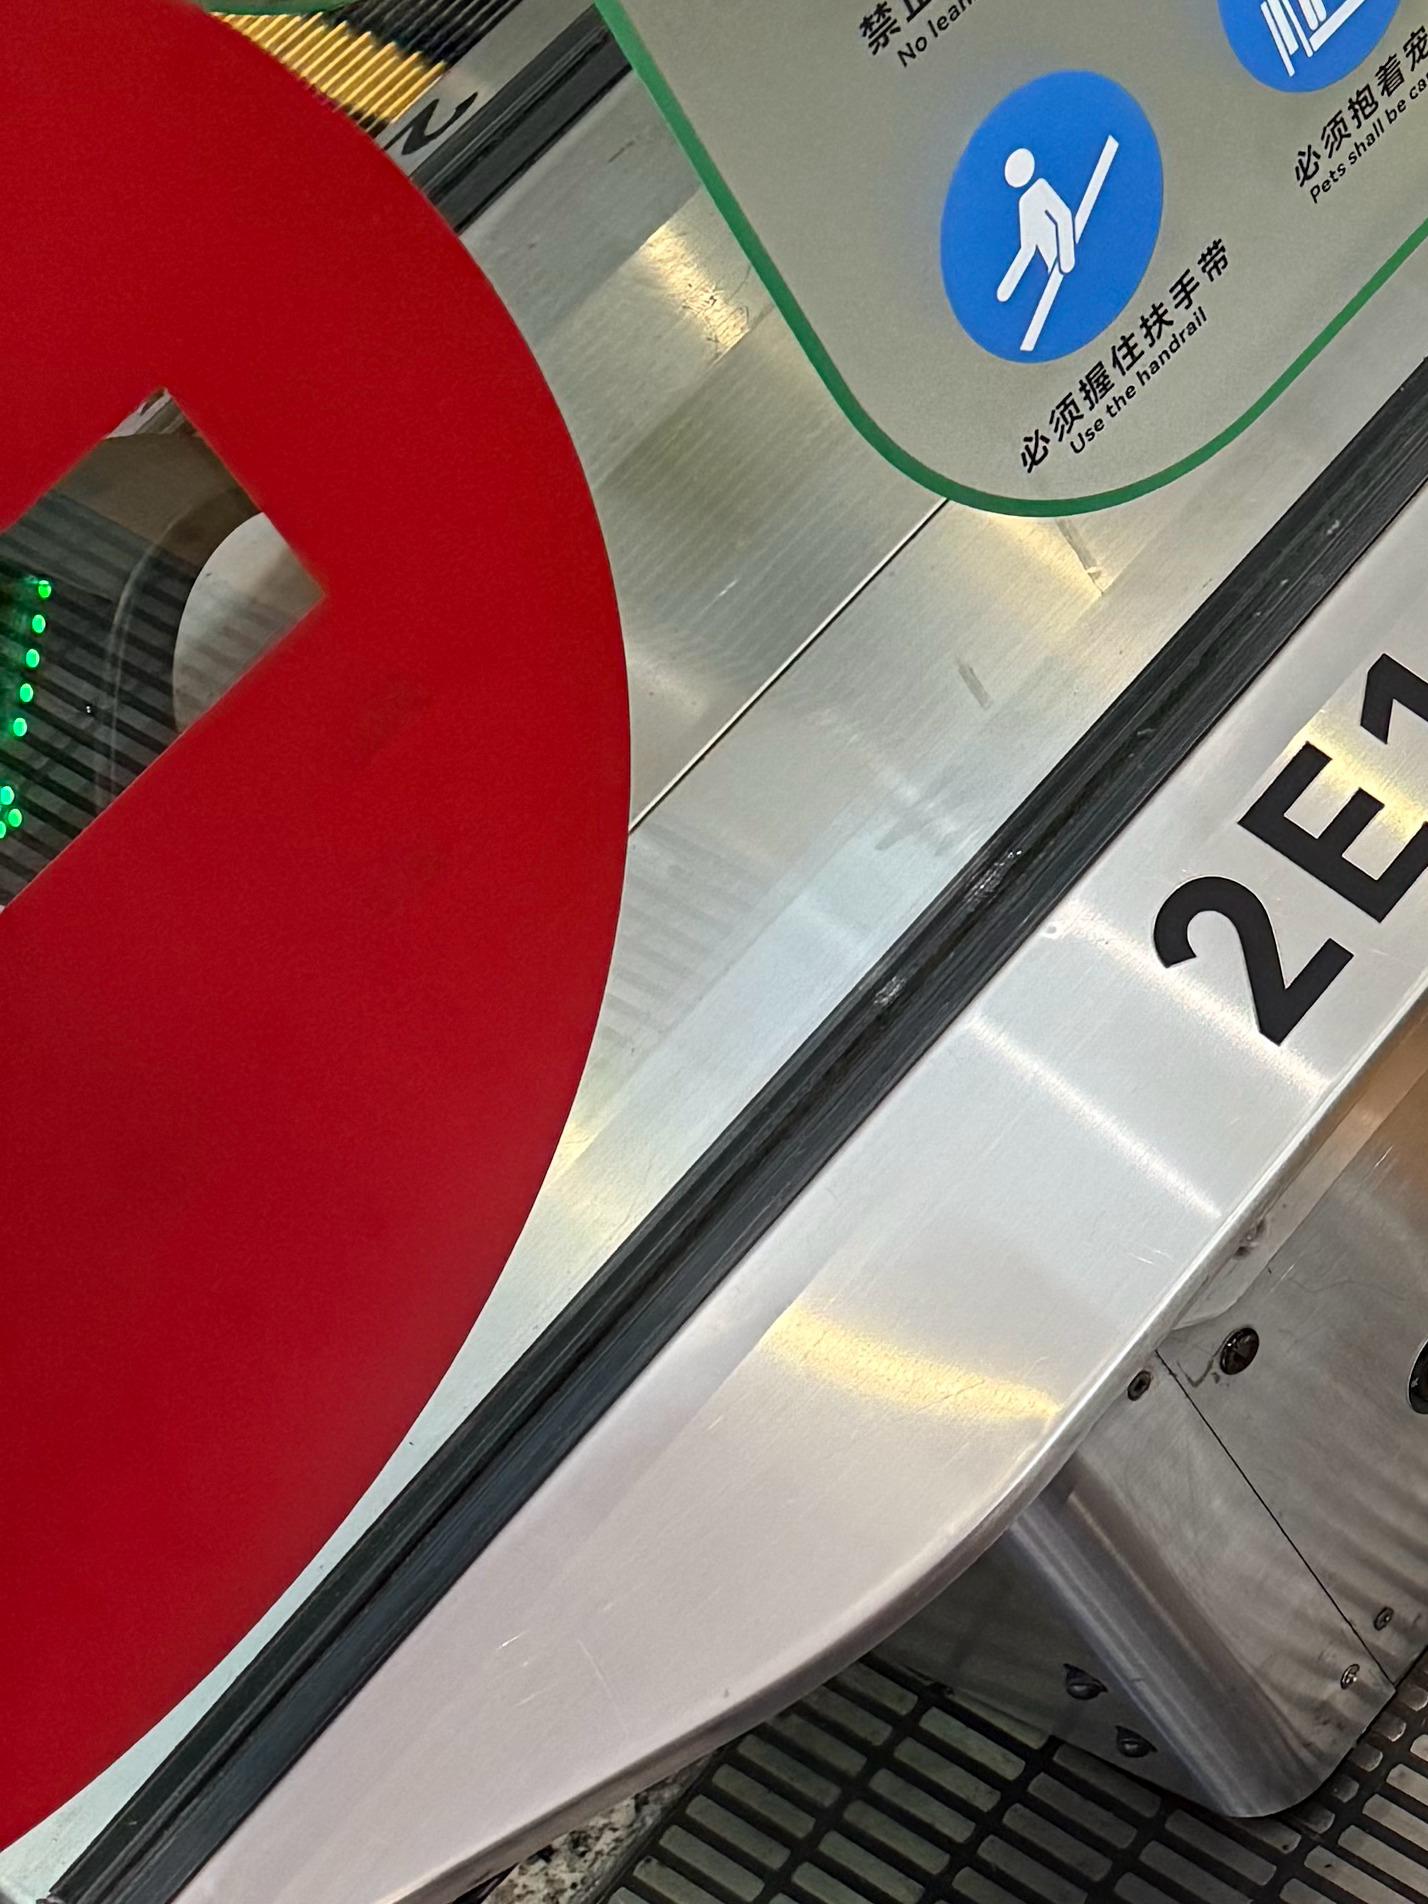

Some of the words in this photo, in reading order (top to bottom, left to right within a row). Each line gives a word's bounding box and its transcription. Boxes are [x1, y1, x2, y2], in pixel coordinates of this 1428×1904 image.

[897, 36, 927, 68] No
[1309, 162, 1347, 204] Pets
[1347, 118, 1385, 165] shall
[1385, 99, 1407, 124] be
[1020, 237, 1229, 474] 必须握住扶手带
[1070, 418, 1105, 454] Use
[1106, 383, 1137, 418] the
[1137, 306, 1208, 386] handrail
